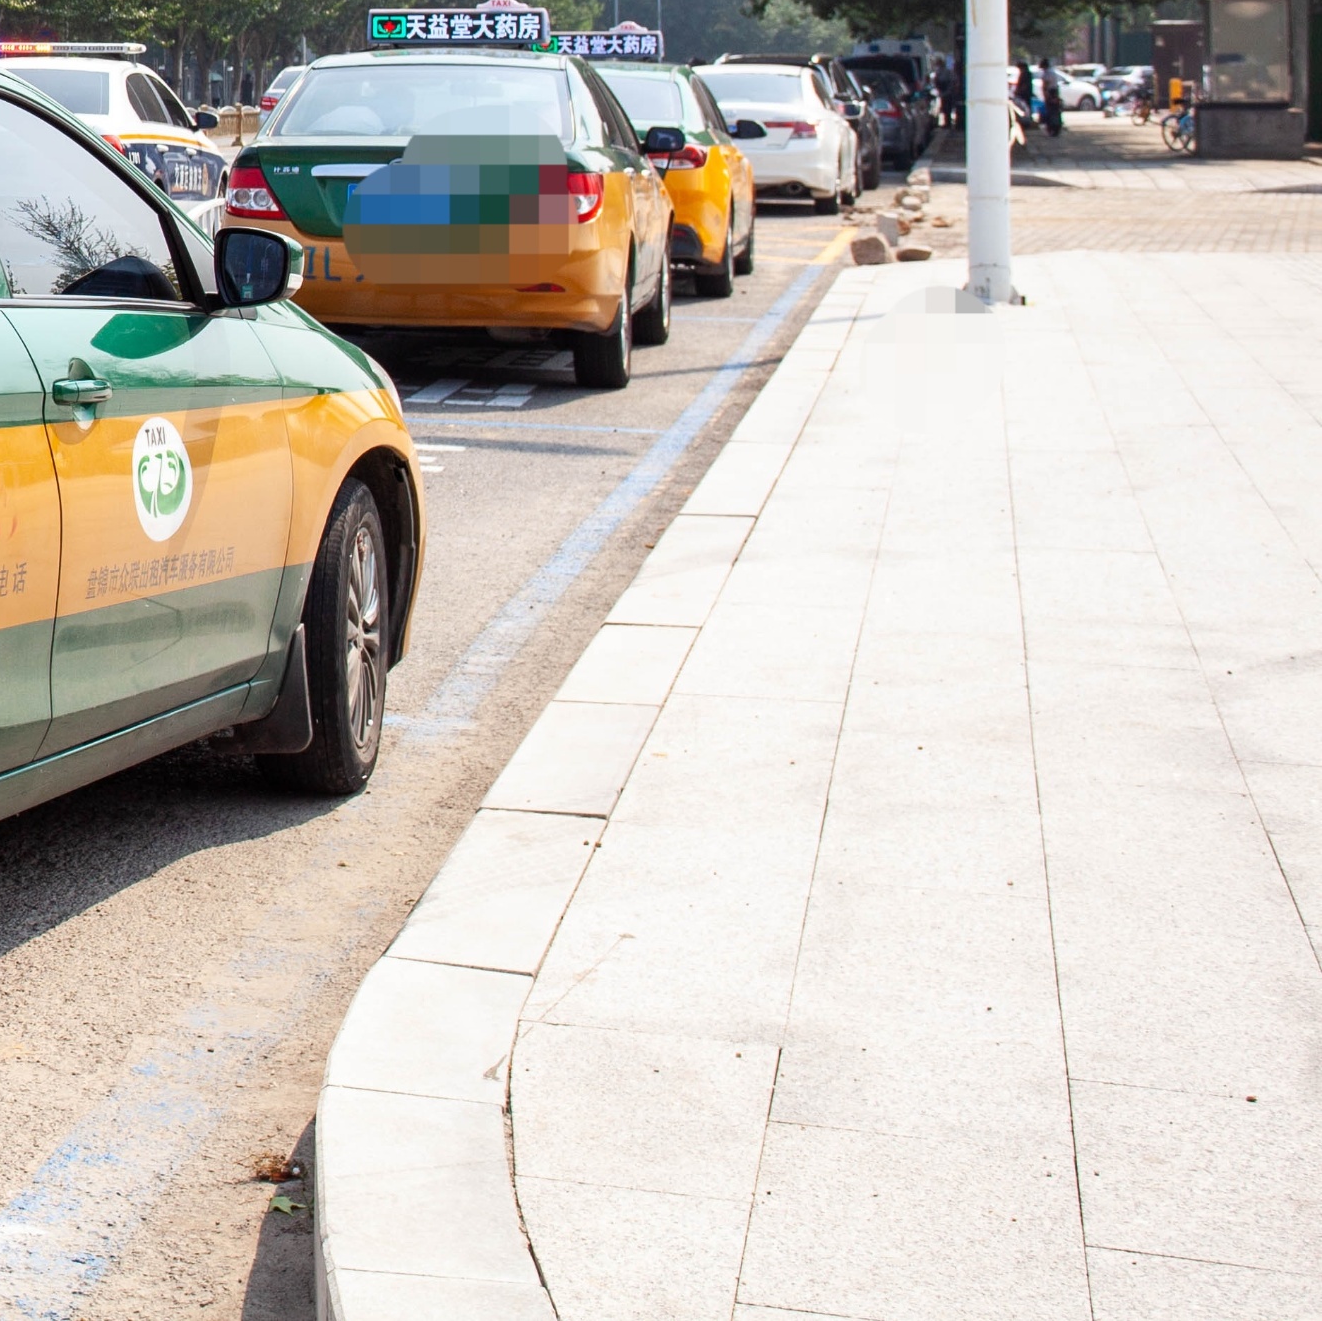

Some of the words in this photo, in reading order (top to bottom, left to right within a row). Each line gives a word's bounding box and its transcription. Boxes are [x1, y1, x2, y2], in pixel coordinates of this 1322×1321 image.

[490, 0, 512, 8] TAXI
[407, 13, 541, 40] 天益堂大药房
[558, 35, 657, 56] 天益堂大药房
[144, 426, 167, 447] TAXI
